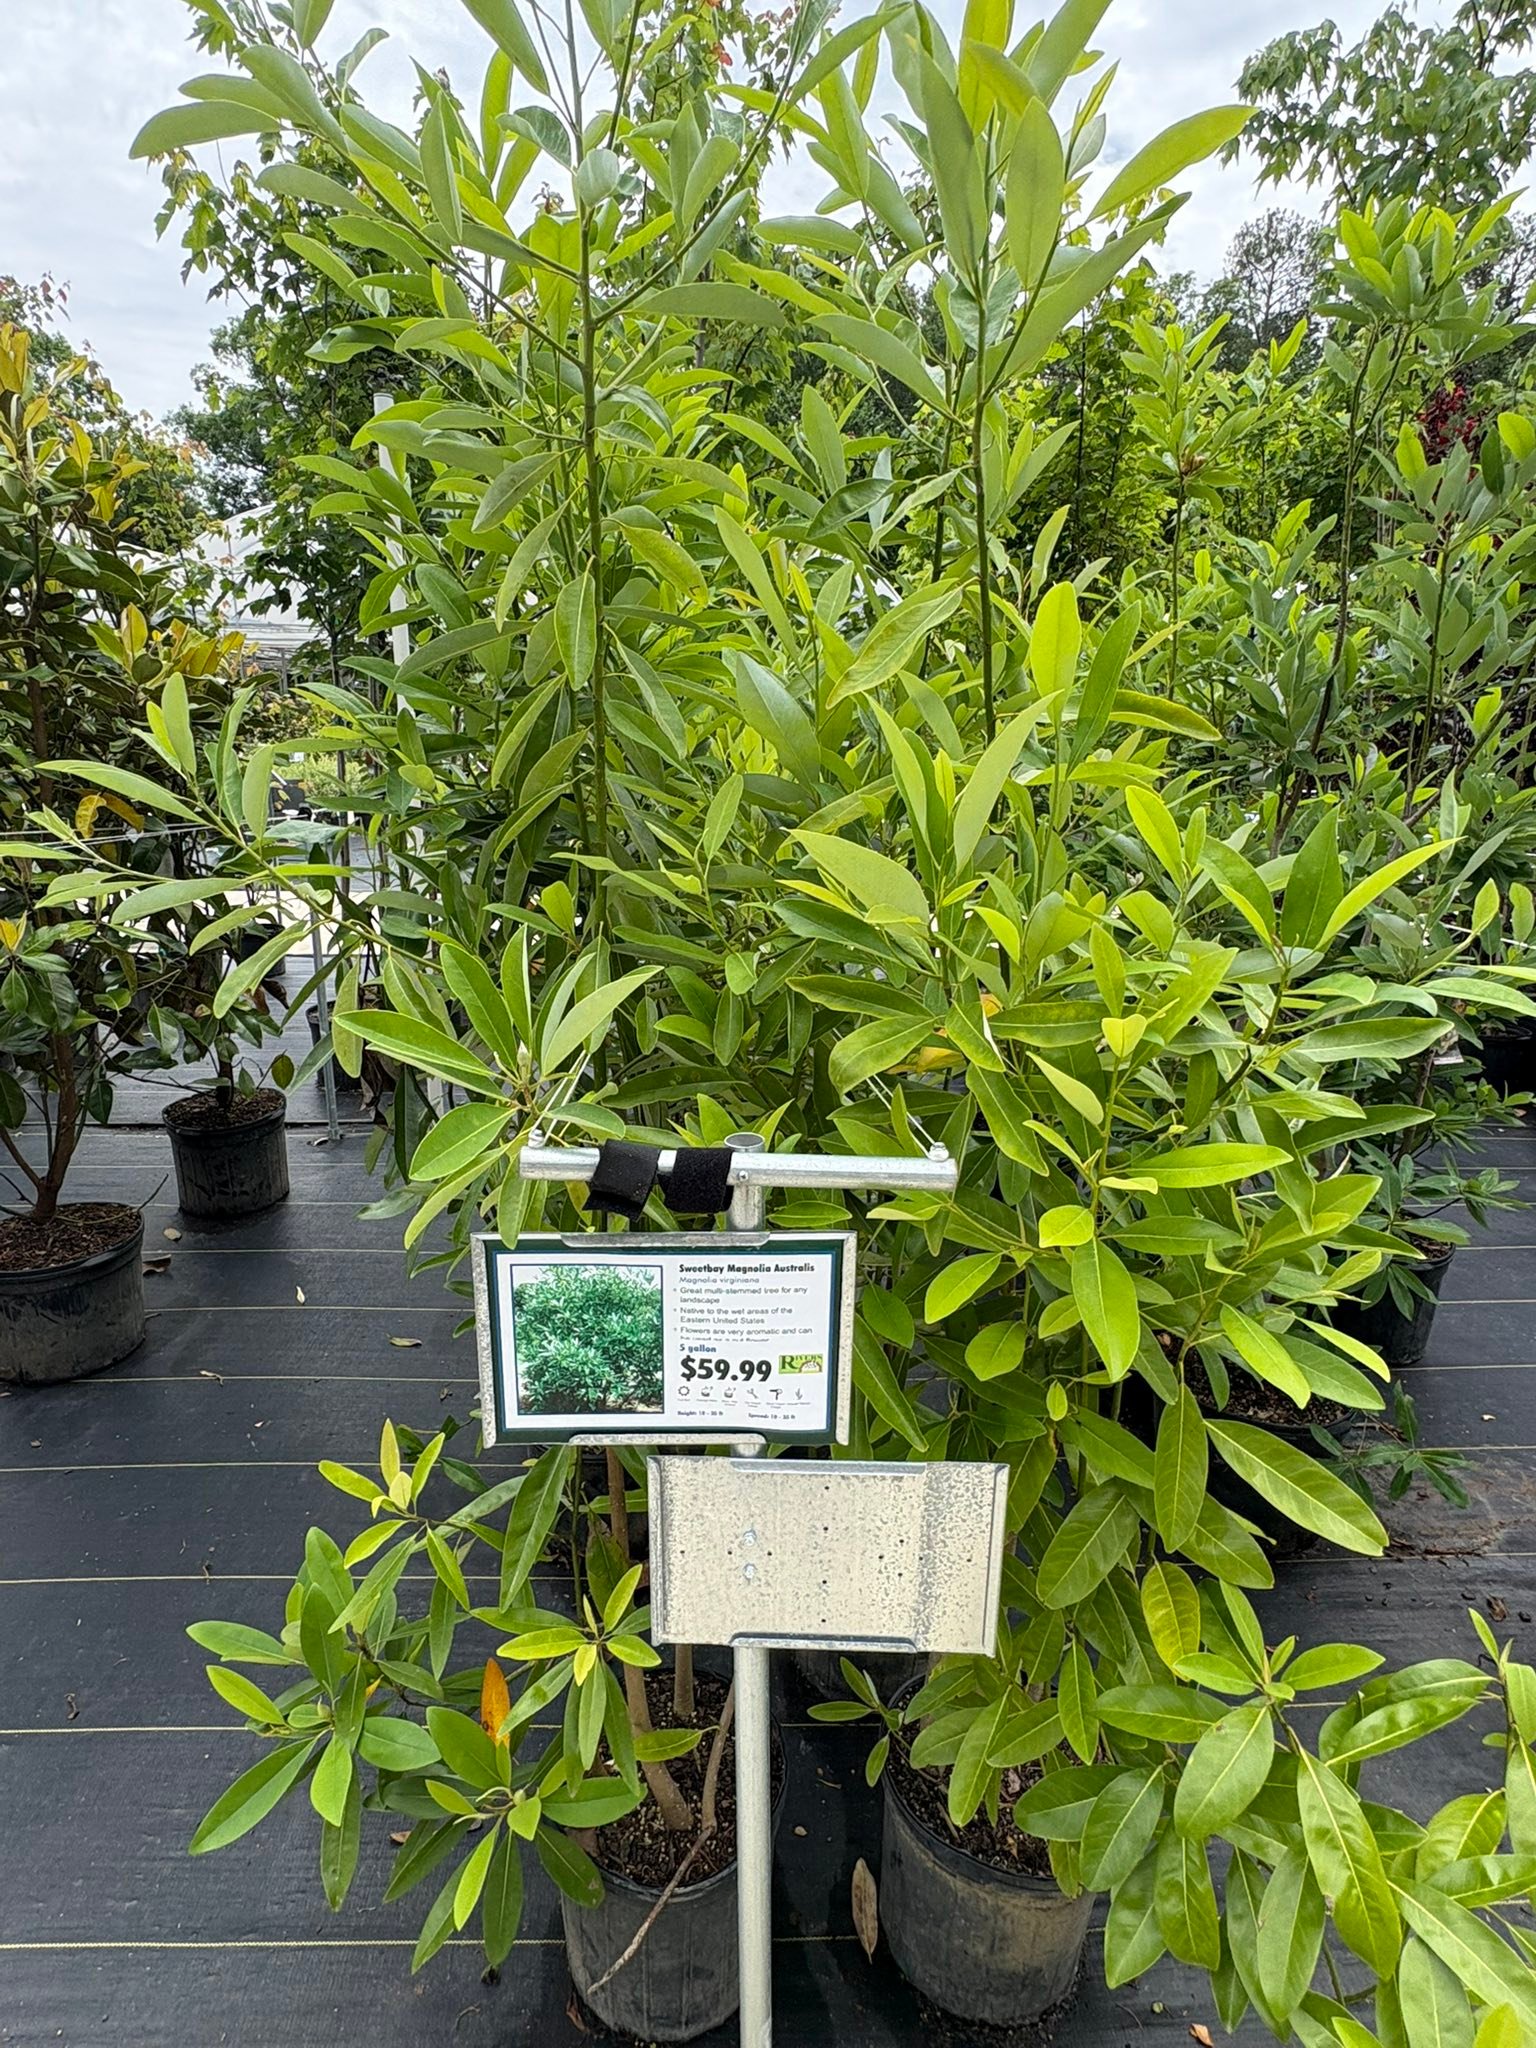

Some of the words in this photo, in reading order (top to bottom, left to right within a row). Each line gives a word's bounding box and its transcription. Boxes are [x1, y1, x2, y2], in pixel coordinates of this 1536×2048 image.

[679, 1264, 724, 1274] Sweetbay
[727, 1264, 770, 1274] Magnolia
[774, 1263, 814, 1272] Australis
[794, 1287, 808, 1295] any
[680, 1296, 720, 1304] landscape
[688, 1344, 716, 1354] gallon
[680, 1354, 772, 1382] $59.99
